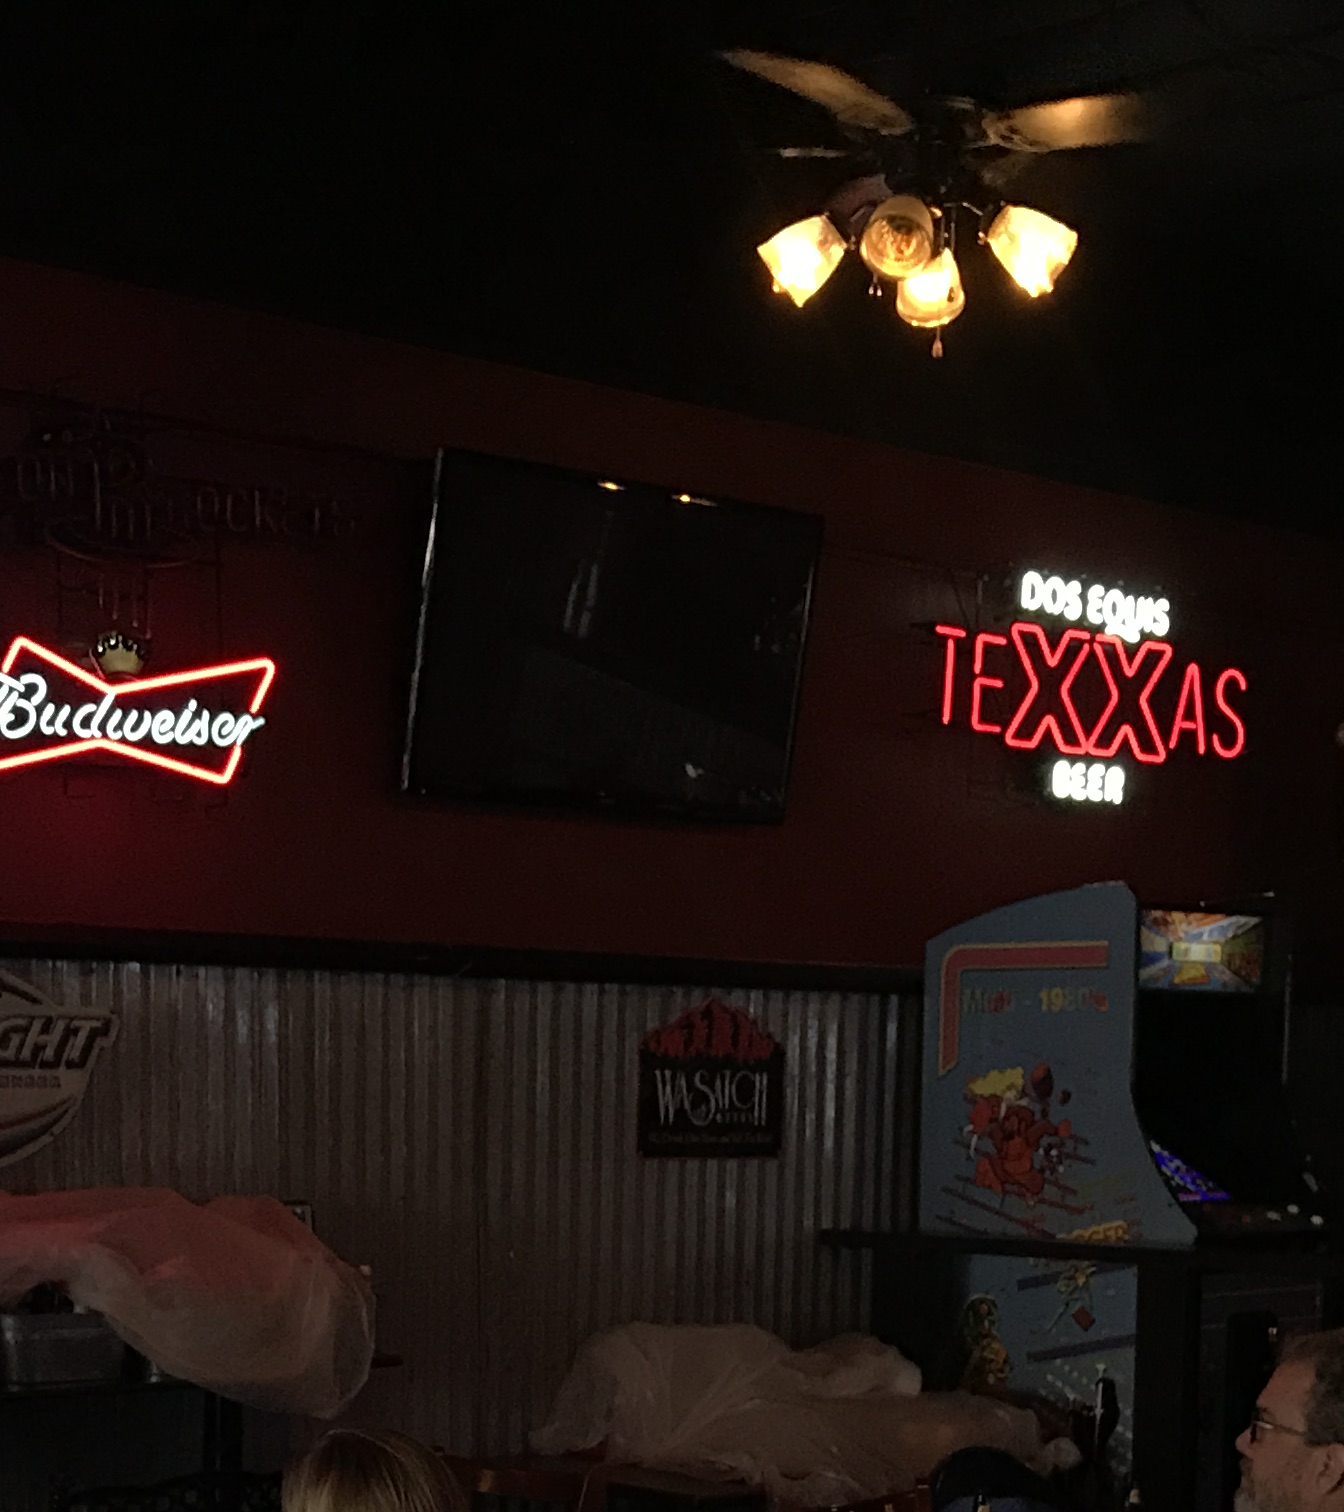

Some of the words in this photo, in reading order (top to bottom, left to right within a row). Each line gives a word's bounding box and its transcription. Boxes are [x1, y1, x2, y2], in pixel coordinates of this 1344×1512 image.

[1021, 570, 1083, 621] DOS
[1086, 583, 1170, 643] EQUIS
[935, 621, 1248, 765] TEXXAS
[1051, 760, 1125, 804] BEER
